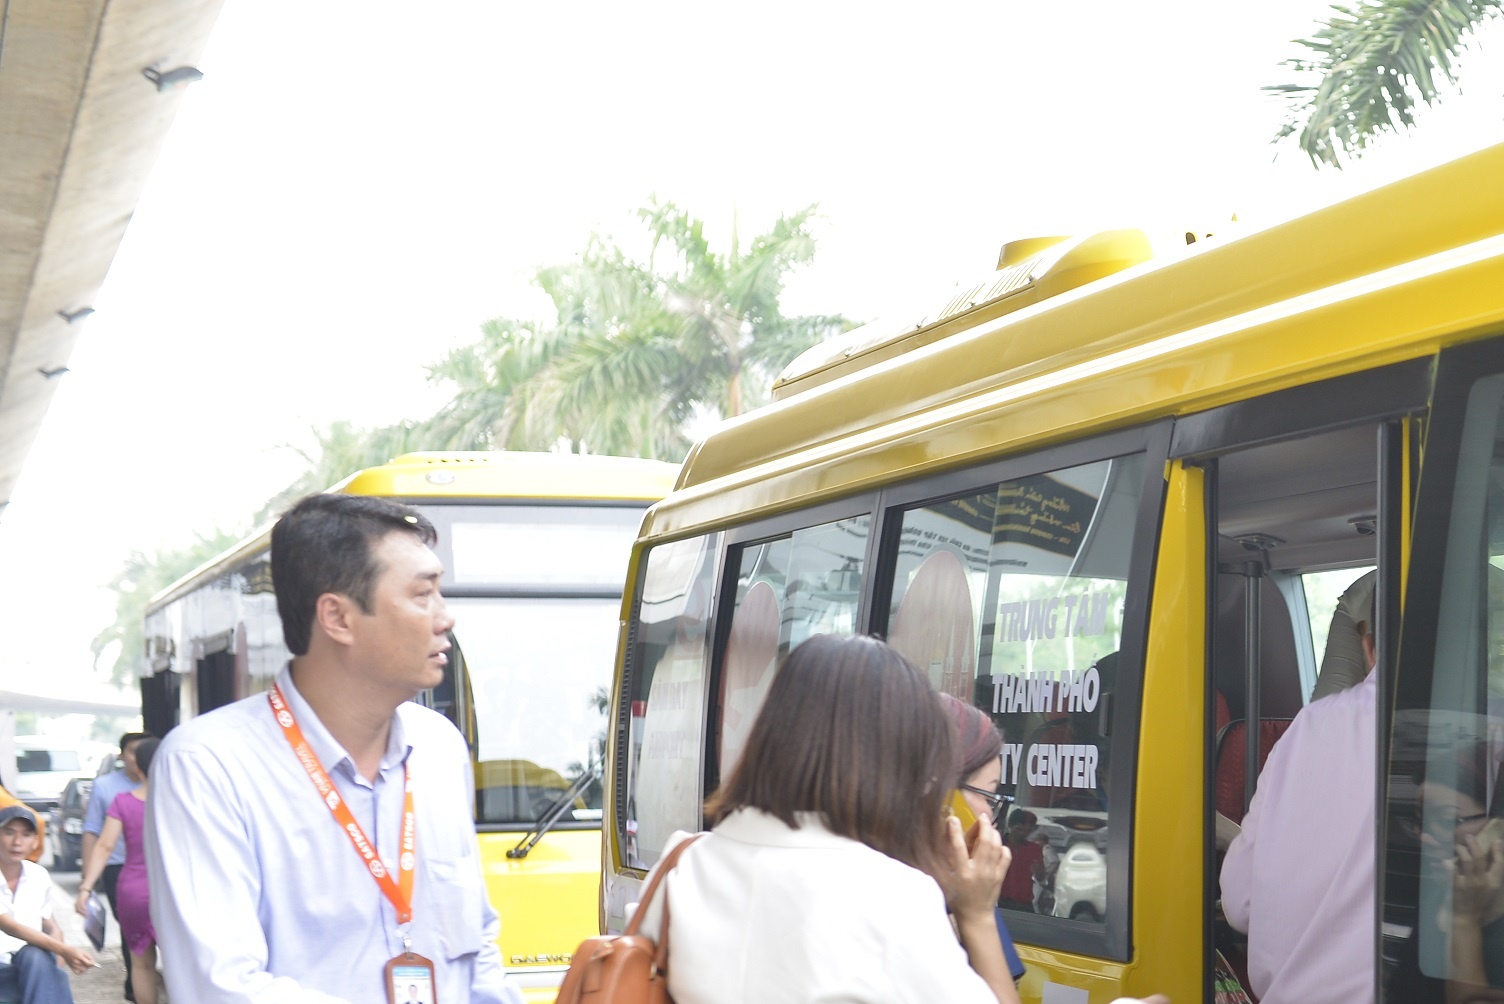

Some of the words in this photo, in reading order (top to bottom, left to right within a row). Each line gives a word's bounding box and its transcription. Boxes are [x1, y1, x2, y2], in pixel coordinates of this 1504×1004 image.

[1000, 597, 1059, 643] TRUNG
[1026, 743, 1099, 789] CENTER
[346, 823, 375, 859] SATSCO
[510, 953, 573, 964] DAEWO
